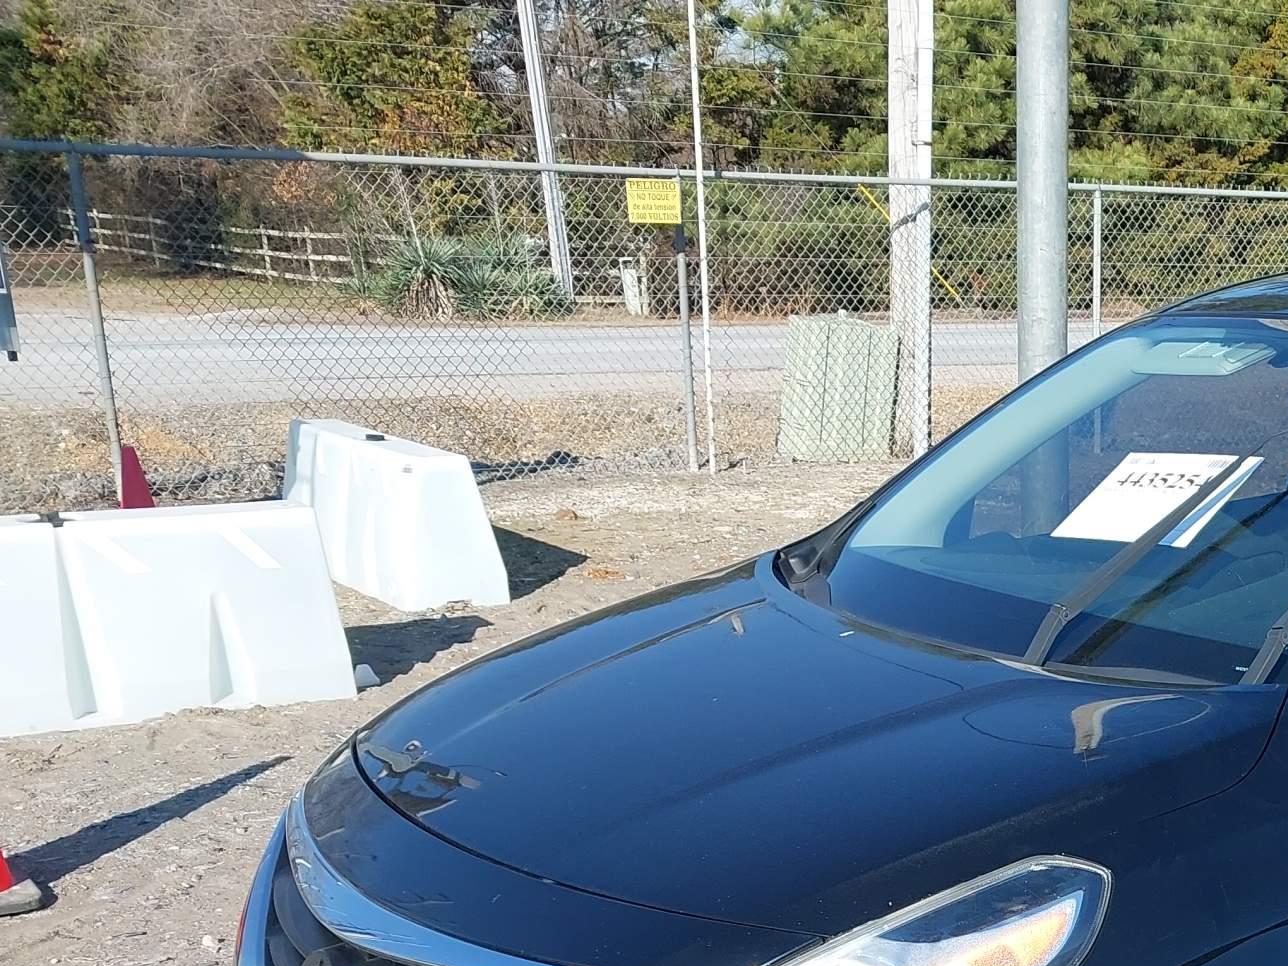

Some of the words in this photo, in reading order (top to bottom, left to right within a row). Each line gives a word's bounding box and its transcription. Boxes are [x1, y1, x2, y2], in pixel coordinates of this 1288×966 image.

[628, 181, 676, 190] PELIGRO
[636, 193, 646, 201] NO
[648, 193, 670, 201] TOQUE
[647, 212, 679, 221] VOLTIOS
